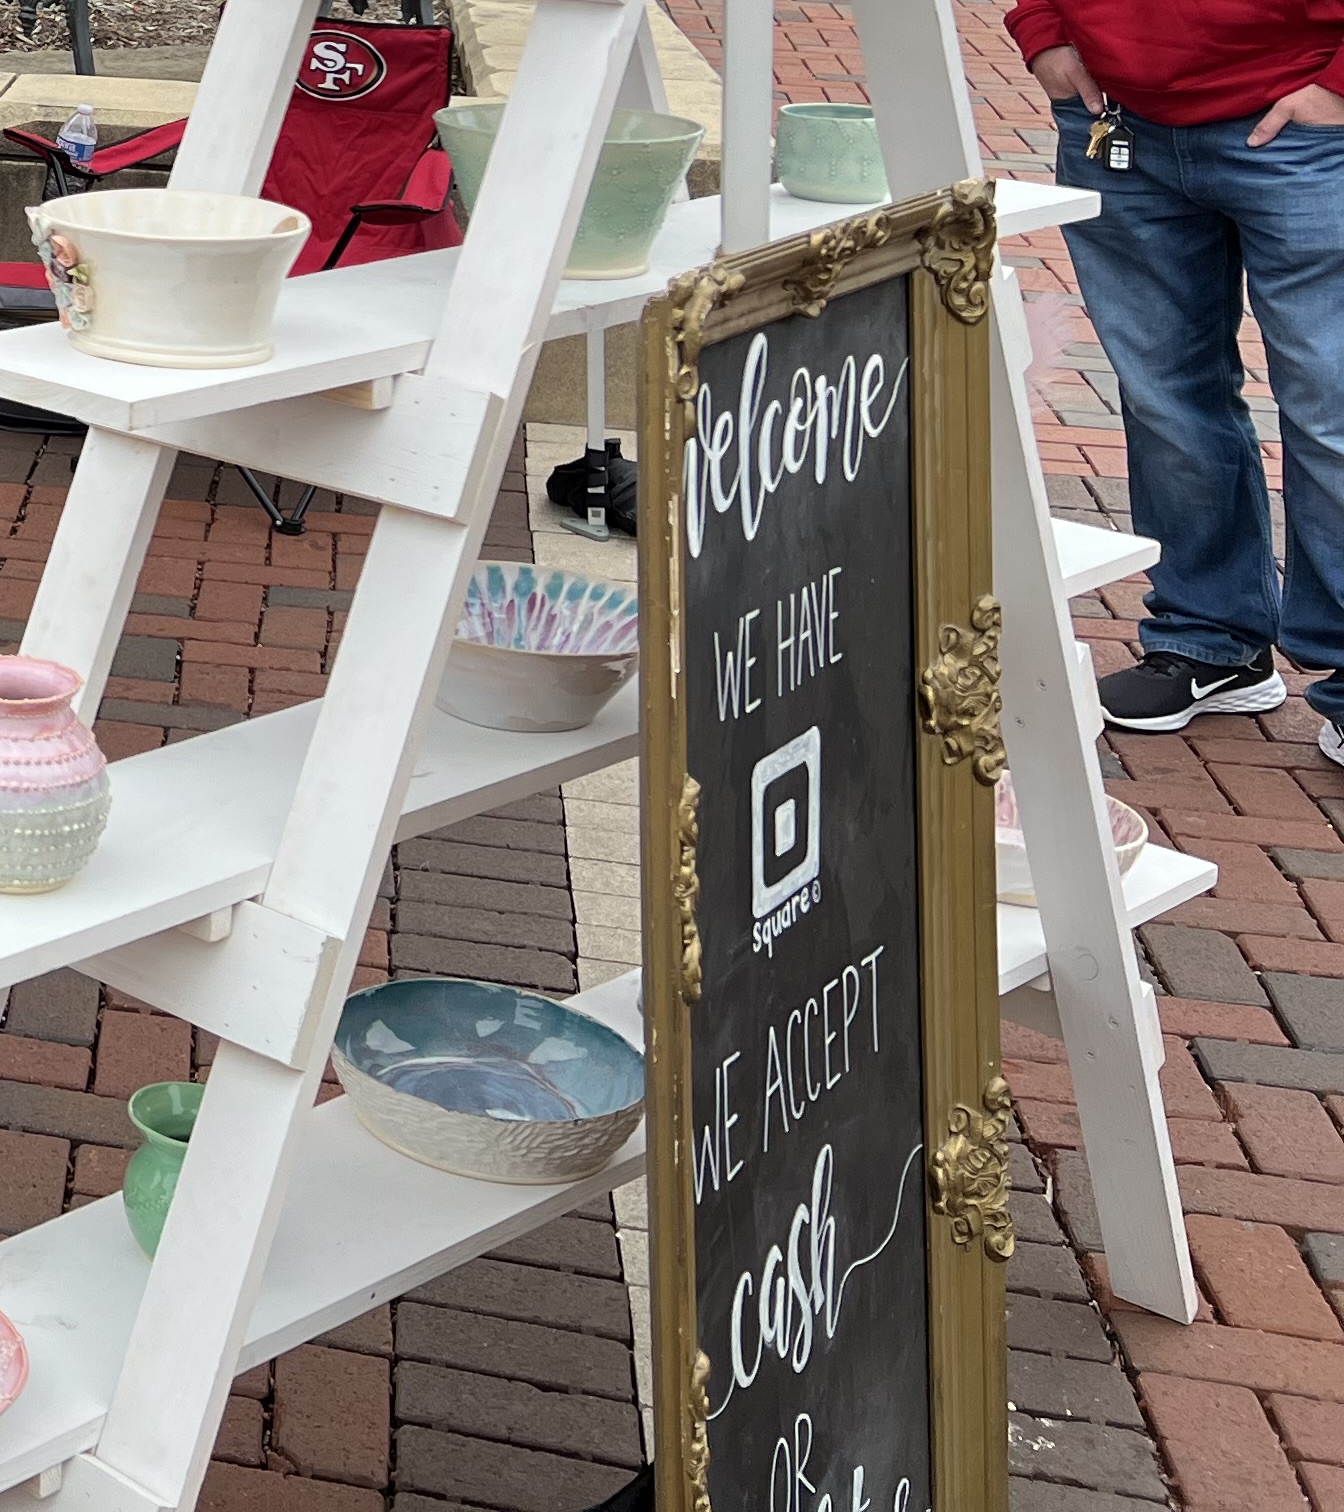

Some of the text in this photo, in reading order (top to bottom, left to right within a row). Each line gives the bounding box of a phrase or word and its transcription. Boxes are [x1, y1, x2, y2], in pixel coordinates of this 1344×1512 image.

[713, 567, 843, 723] WE HAVE
[691, 945, 885, 1205] WE ACCEPT
[708, 1144, 884, 1406] cash
[770, 1413, 816, 1512] OR
